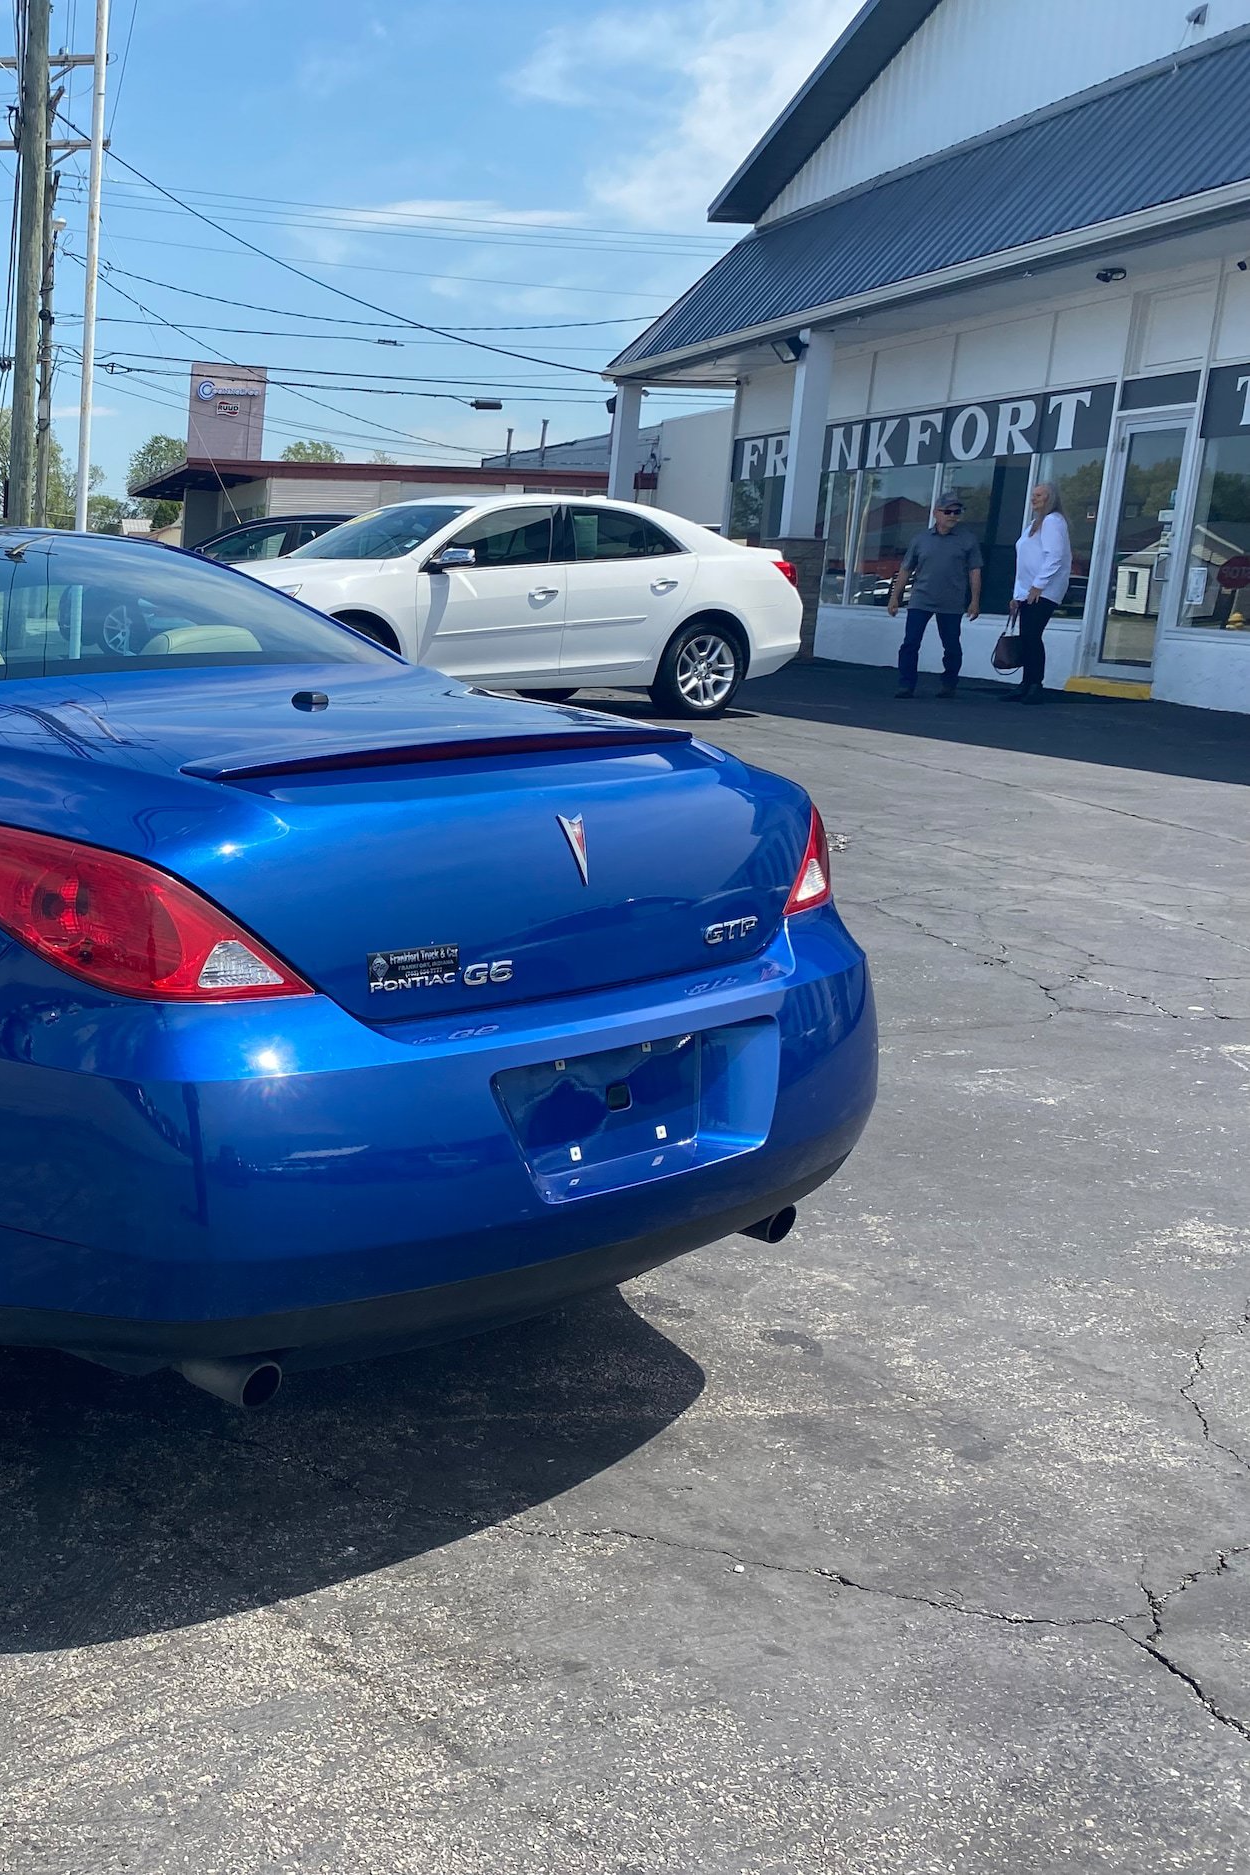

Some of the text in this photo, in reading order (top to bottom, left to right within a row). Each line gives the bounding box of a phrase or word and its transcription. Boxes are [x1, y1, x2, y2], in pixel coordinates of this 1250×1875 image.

[740, 391, 1091, 481] FRNKFORT
[704, 915, 758, 945] GTP
[390, 951, 420, 965] Frankfort
[420, 949, 439, 961] Truck
[439, 947, 446, 959] &
[369, 959, 514, 994] PONTIAC G6
